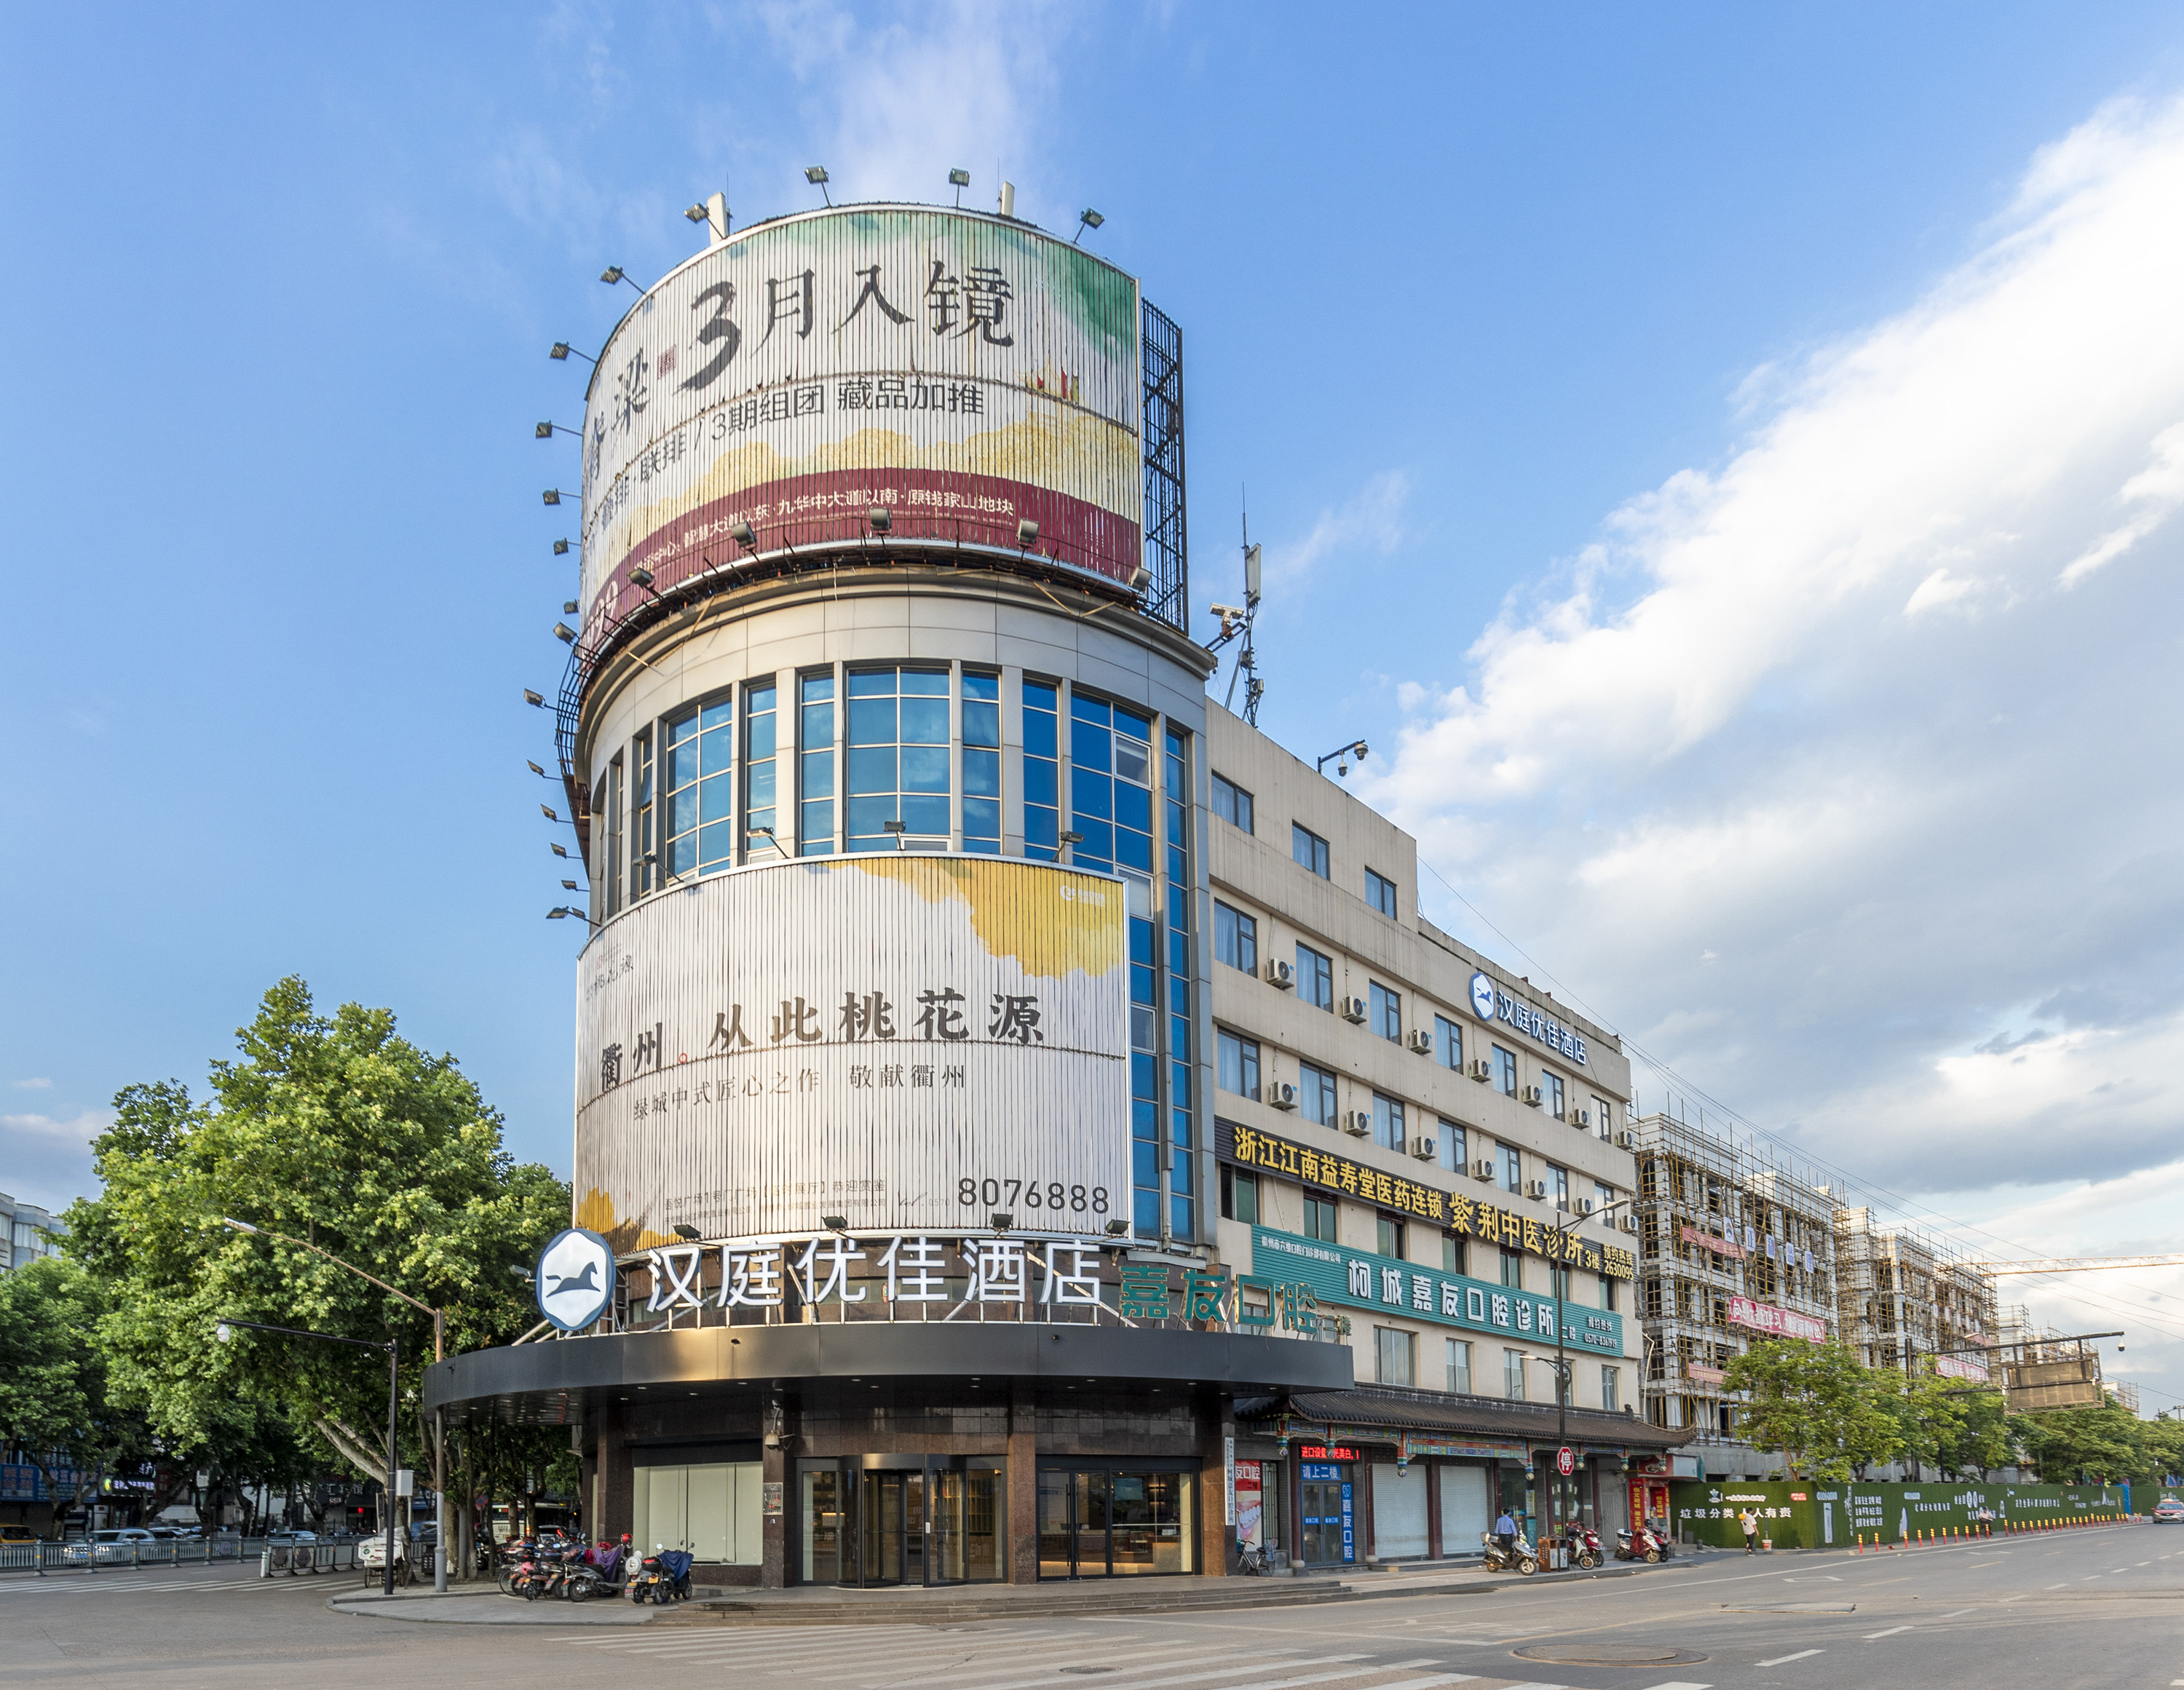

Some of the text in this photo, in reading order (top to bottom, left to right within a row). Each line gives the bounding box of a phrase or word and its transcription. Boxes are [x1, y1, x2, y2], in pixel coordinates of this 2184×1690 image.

[1496, 988, 1587, 1066] 汉庭优佳酒店
[848, 1063, 966, 1090] 敬献衢州
[958, 1177, 1108, 1214] 8076888
[1234, 1126, 1444, 1221] 浙江江南益寿堂医药连锁
[1585, 1249, 1600, 1271] 3楼
[1603, 1243, 1634, 1266] 预约热线
[646, 1237, 1101, 1314] 汉庭优佳酒店
[1605, 1259, 1634, 1281] 2630095
[1118, 1265, 1319, 1335] 嘉友口腔
[1348, 1258, 1554, 1336] 柯城嘉友口腔诊所
[1302, 1464, 1338, 1479] 请上二楼
[1560, 1452, 1572, 1472] 停
[1342, 1499, 1353, 1559] 嘉友口腔
[1680, 1507, 1735, 1519] 垃圾分类
